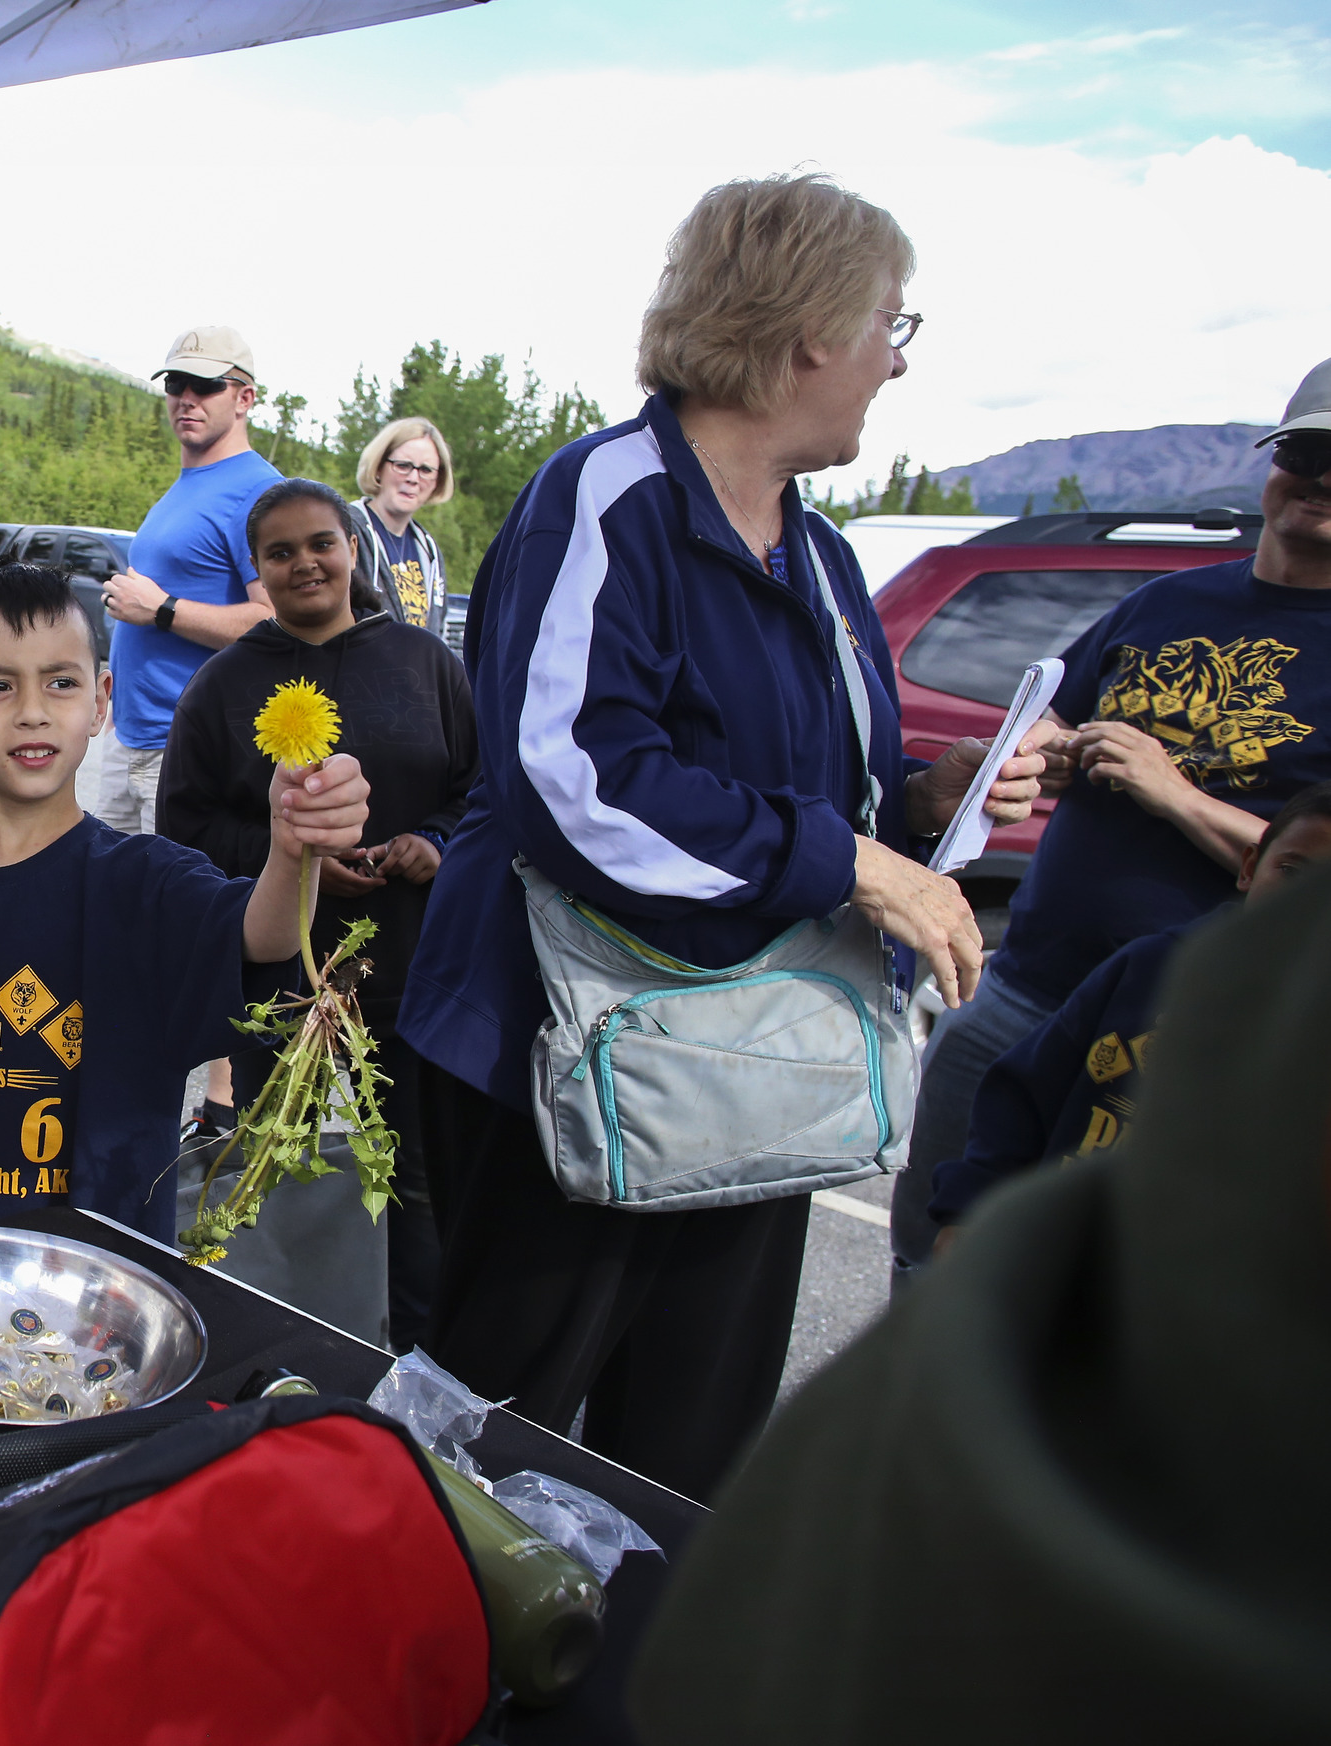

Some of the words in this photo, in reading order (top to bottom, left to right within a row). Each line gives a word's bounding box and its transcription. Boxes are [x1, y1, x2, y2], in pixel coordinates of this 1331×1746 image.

[13, 1007, 33, 1015] WOLF
[21, 1097, 64, 1164] 6
[34, 1167, 70, 1194] AK
